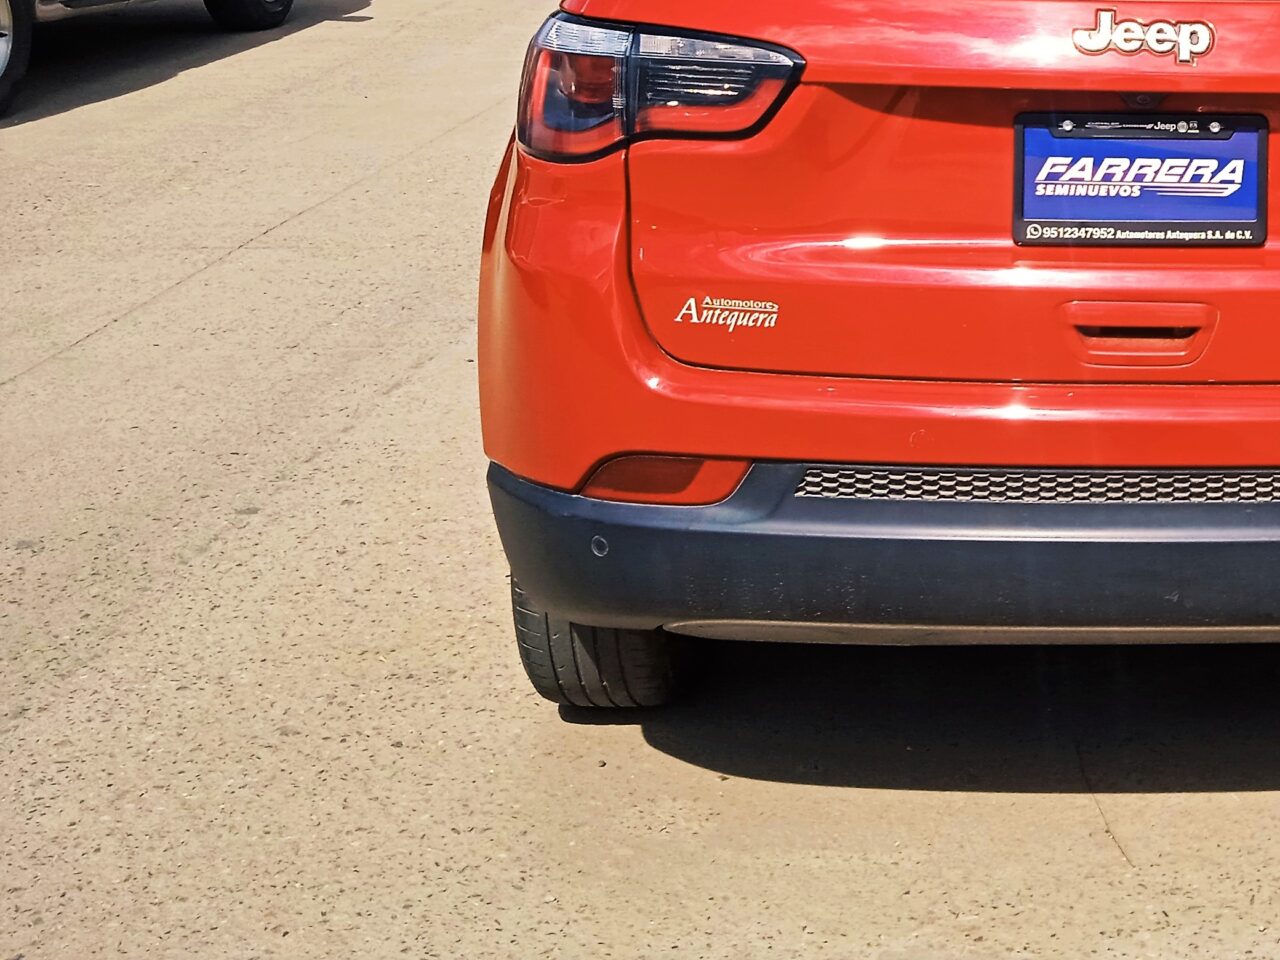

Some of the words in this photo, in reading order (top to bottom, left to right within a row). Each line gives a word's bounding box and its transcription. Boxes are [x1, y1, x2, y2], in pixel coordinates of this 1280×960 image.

[1072, 9, 1214, 64] Jeep
[1154, 122, 1176, 132] Jeep
[1036, 156, 1245, 183] FARRERA
[1034, 184, 1141, 197] SEMINUEVOS
[1043, 227, 1115, 239] 9512347952
[1207, 230, 1224, 240] S.A.
[702, 296, 779, 310] Automotores
[674, 298, 778, 333] Antequera
